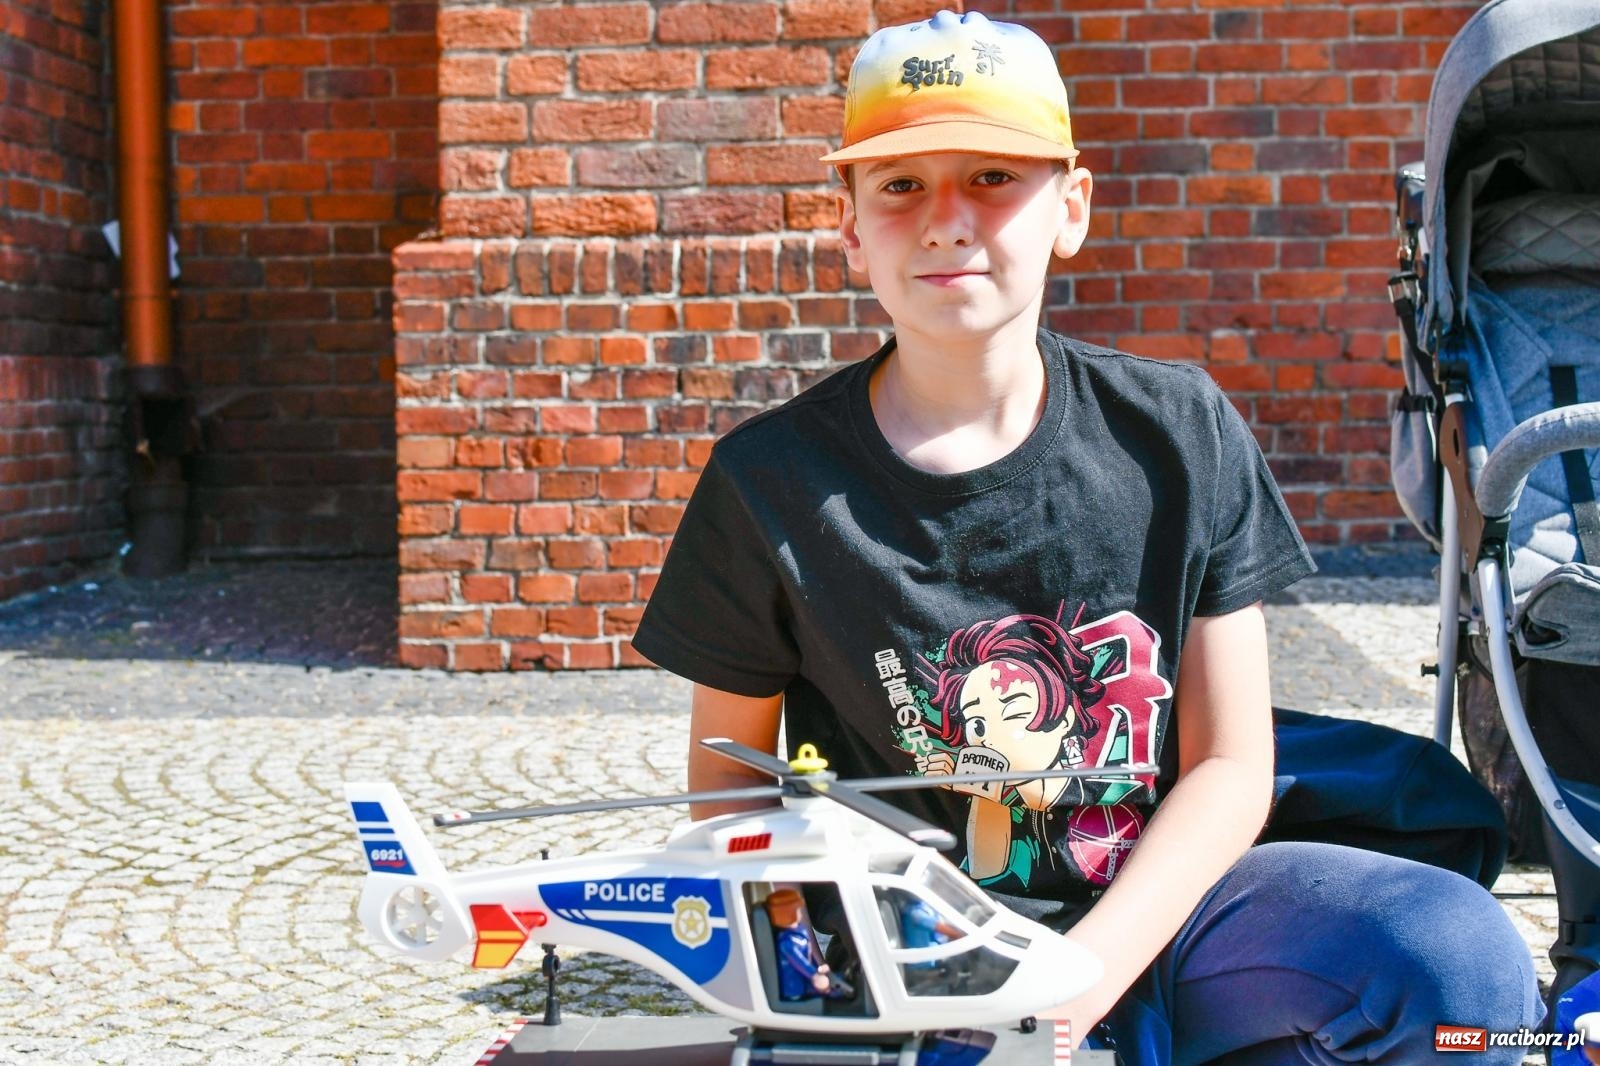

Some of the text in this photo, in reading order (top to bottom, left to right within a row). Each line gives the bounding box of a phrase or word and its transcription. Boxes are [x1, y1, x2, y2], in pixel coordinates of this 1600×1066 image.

[961, 753, 1005, 772] BROTHER
[371, 848, 403, 861] 6921
[584, 882, 666, 902] POLICE
